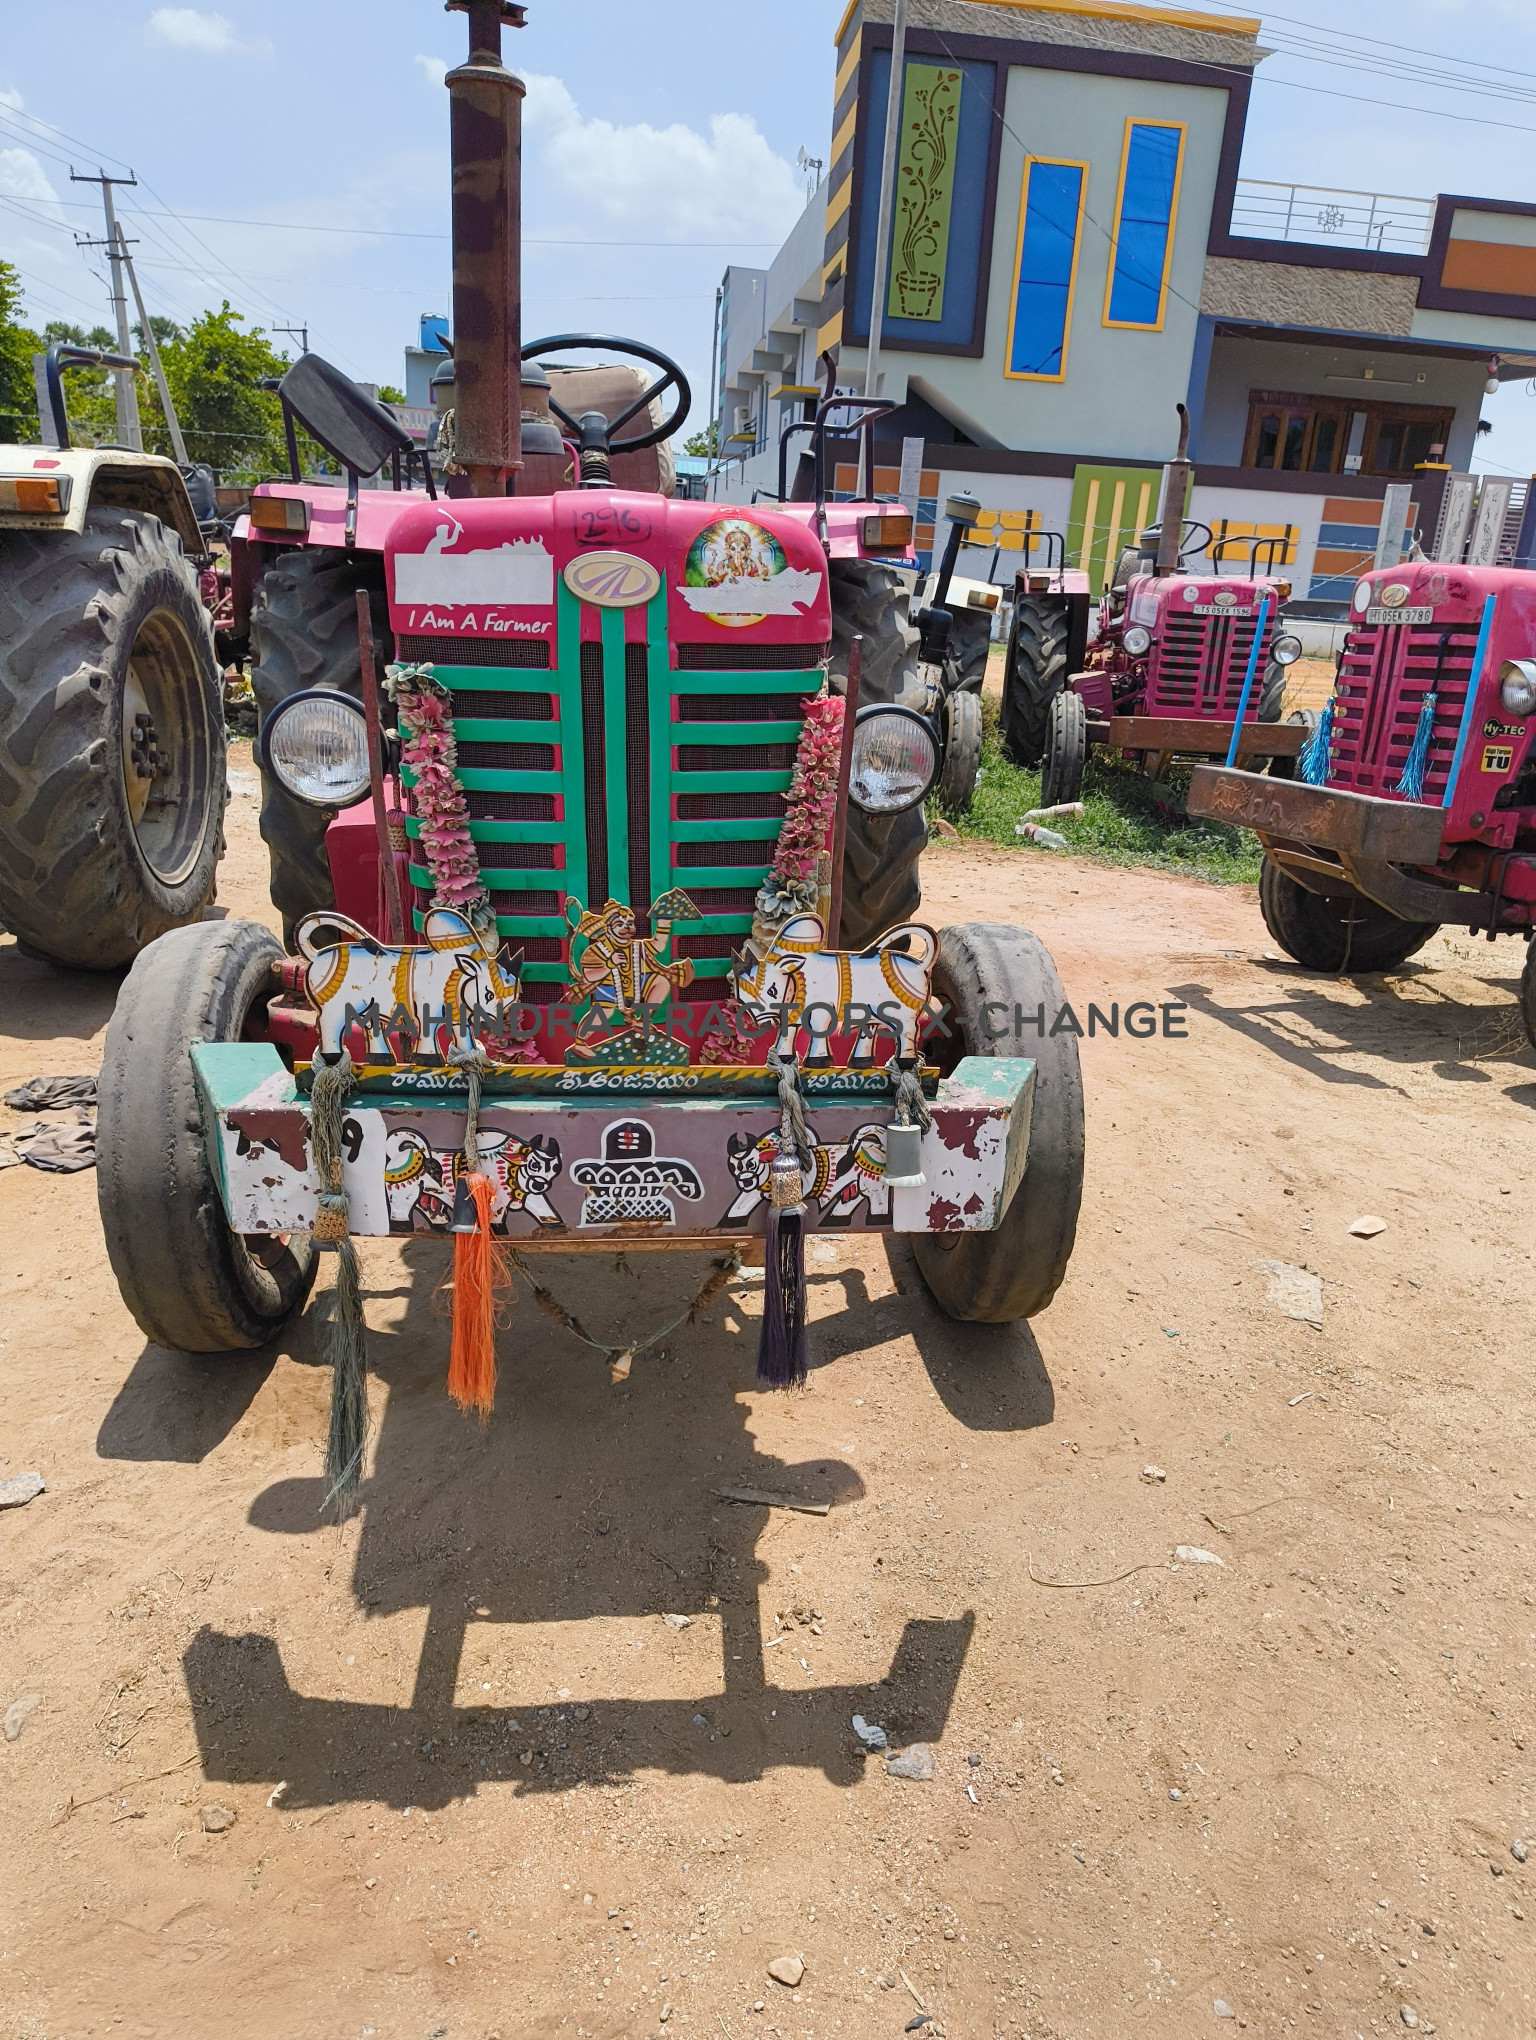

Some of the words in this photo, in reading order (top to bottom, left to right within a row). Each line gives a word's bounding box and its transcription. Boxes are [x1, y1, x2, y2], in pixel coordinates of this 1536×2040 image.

[581, 507, 641, 538] 296
[408, 609, 416, 628] I
[419, 610, 455, 630] Am
[459, 612, 478, 631] A
[483, 612, 553, 634] Farmer
[1483, 723, 1526, 735] Hy-TEC
[1484, 756, 1510, 769] TU
